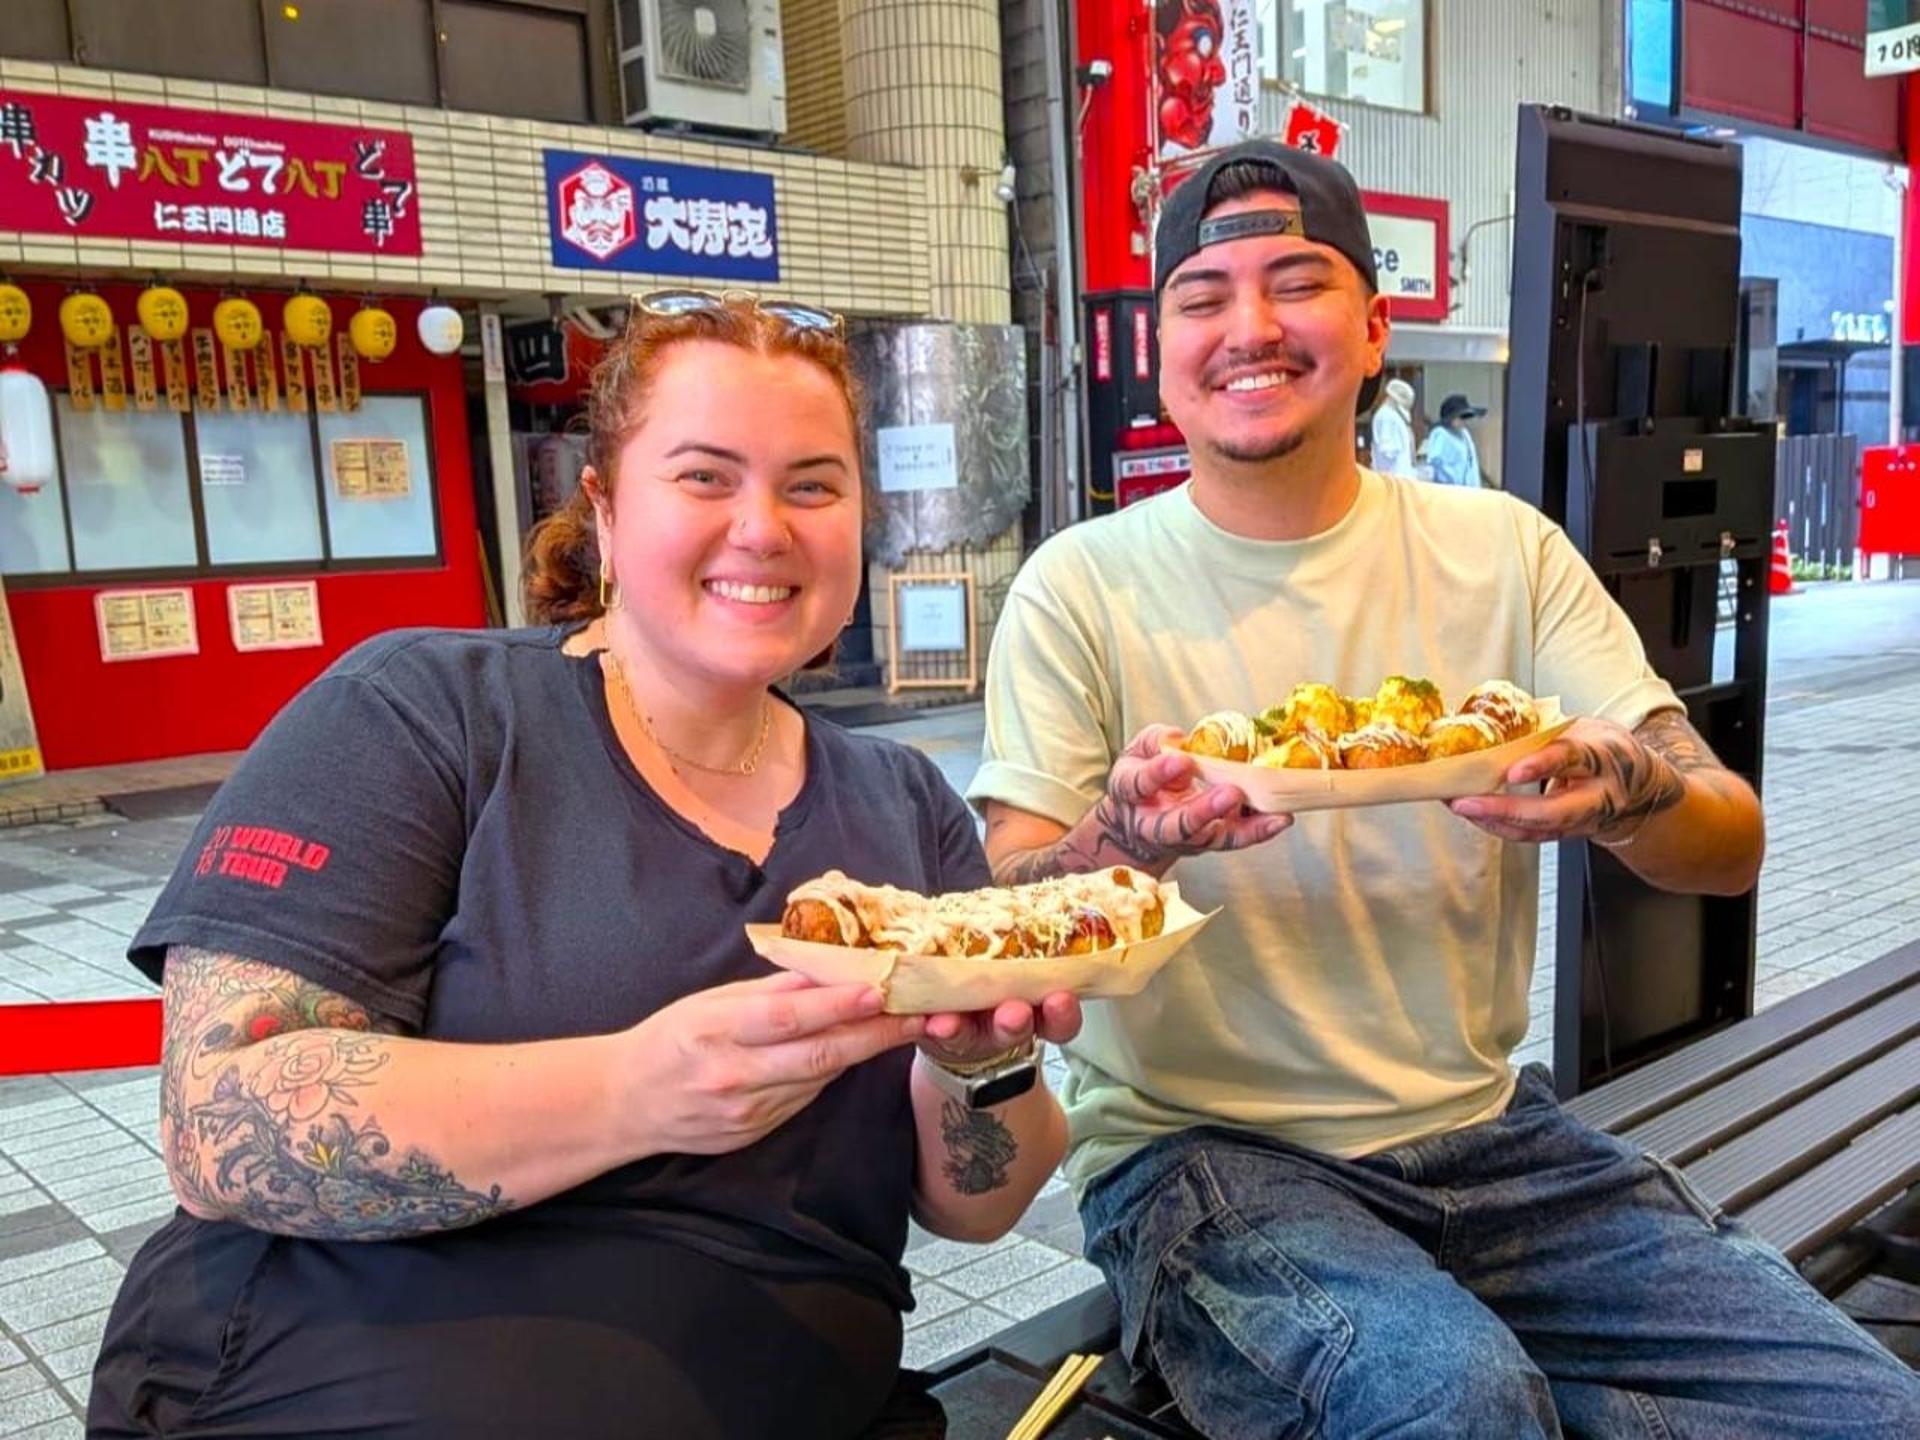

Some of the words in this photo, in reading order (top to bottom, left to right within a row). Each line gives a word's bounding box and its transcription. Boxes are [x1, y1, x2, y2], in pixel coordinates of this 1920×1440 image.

[1230, 8, 1253, 132] 仁王門通り
[153, 199, 286, 239] 仁王門通店
[1401, 276, 1431, 293] SMITH
[232, 826, 330, 869] WORLD
[219, 852, 288, 887] TOUR
